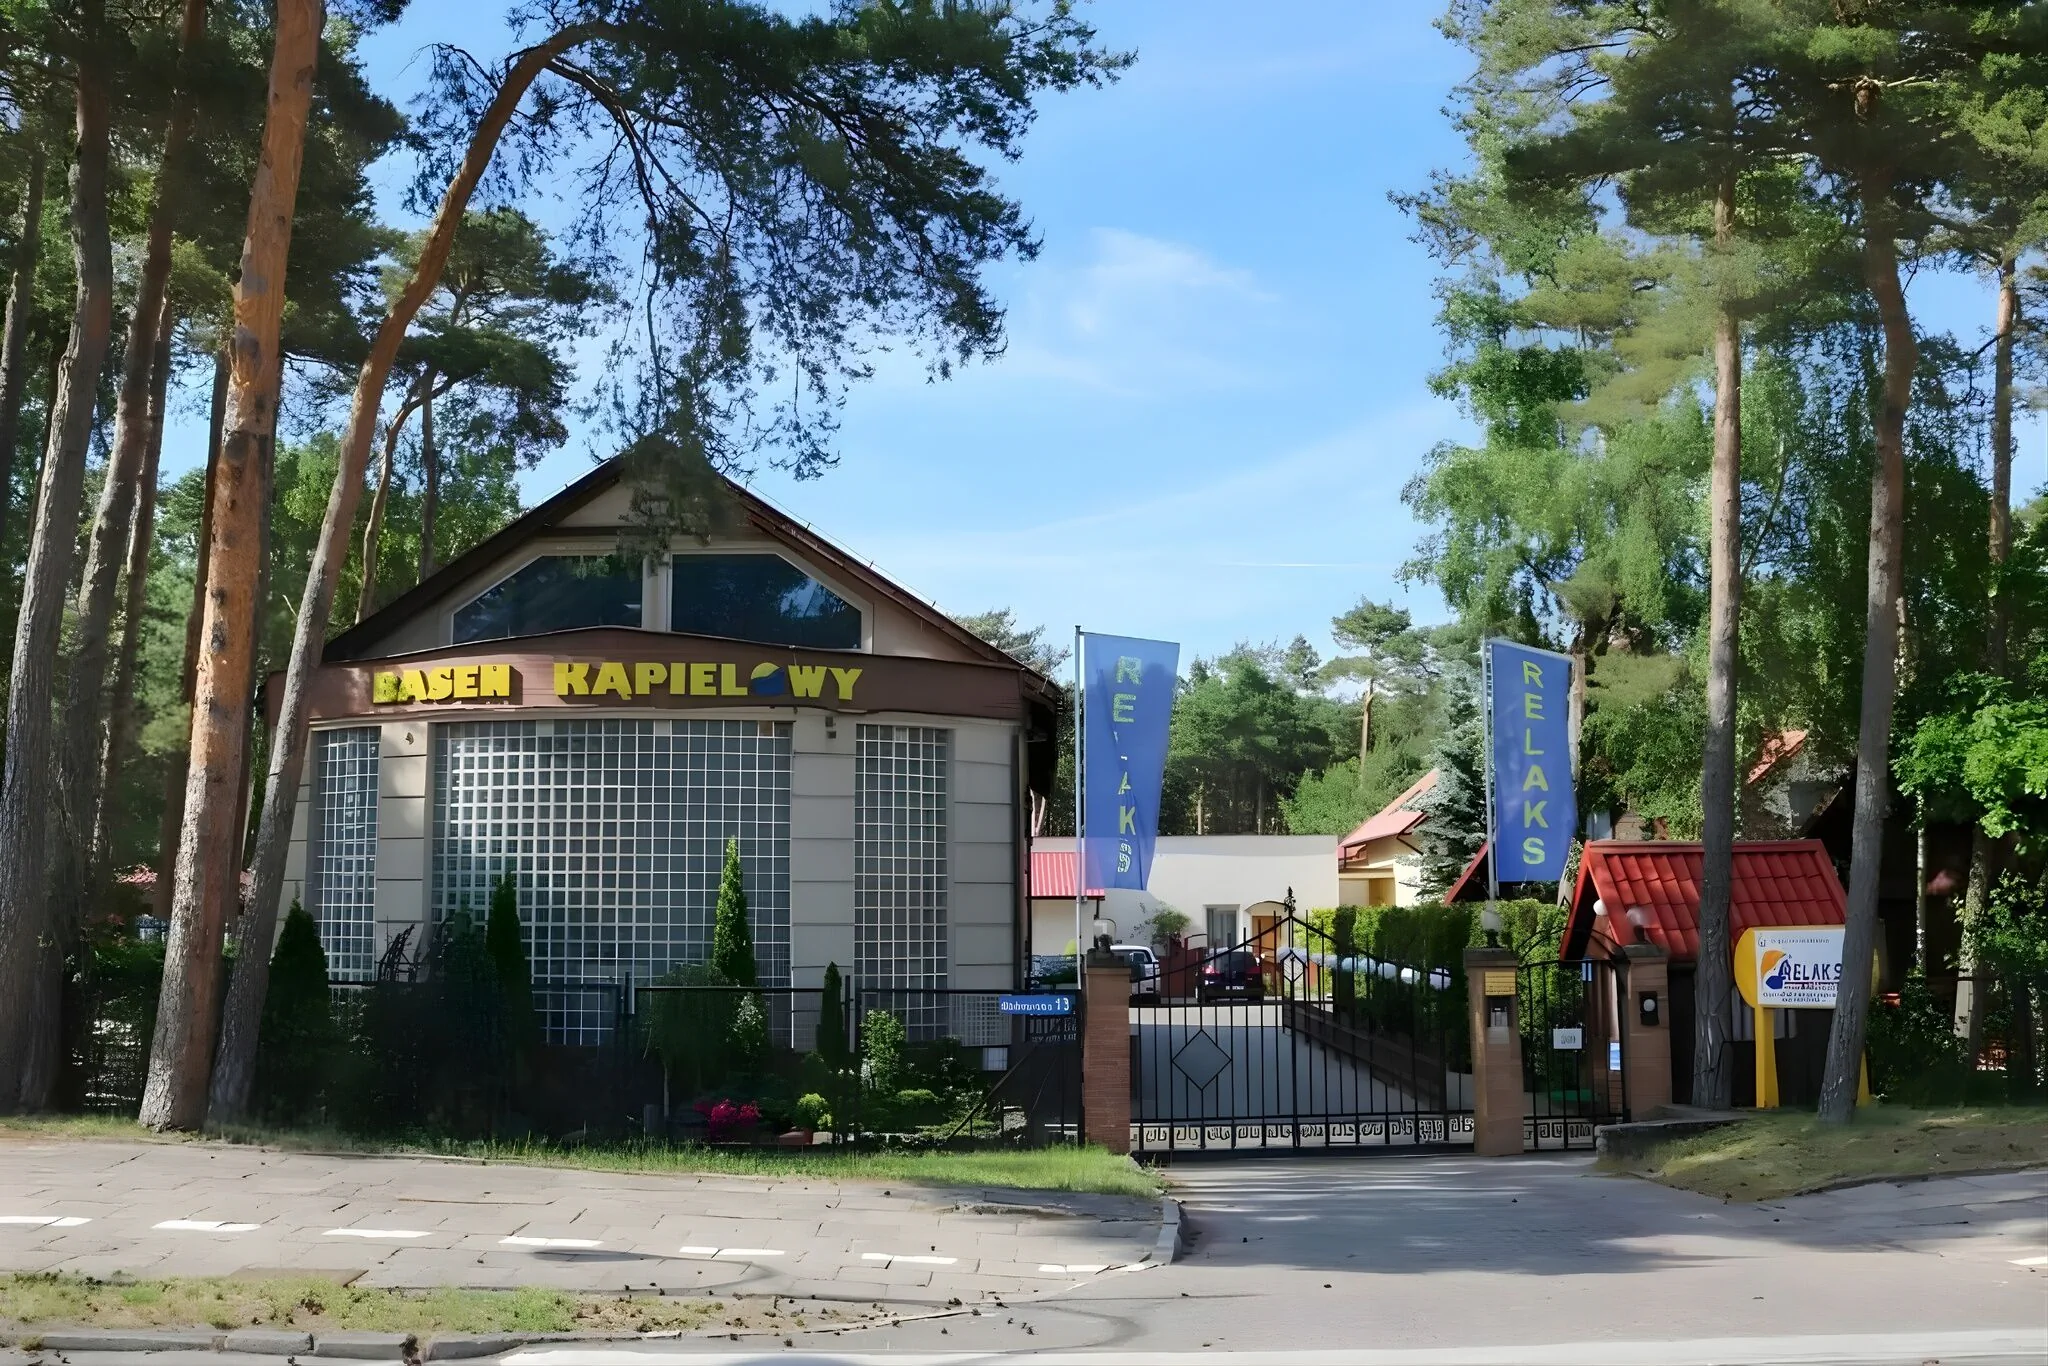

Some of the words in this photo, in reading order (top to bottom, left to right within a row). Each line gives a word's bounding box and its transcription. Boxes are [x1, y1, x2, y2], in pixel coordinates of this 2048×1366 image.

[373, 664, 510, 703] BASEN
[1112, 655, 1143, 873] REAKS
[1522, 660, 1549, 865] RELAKS
[1780, 961, 1843, 981] RELAKS
